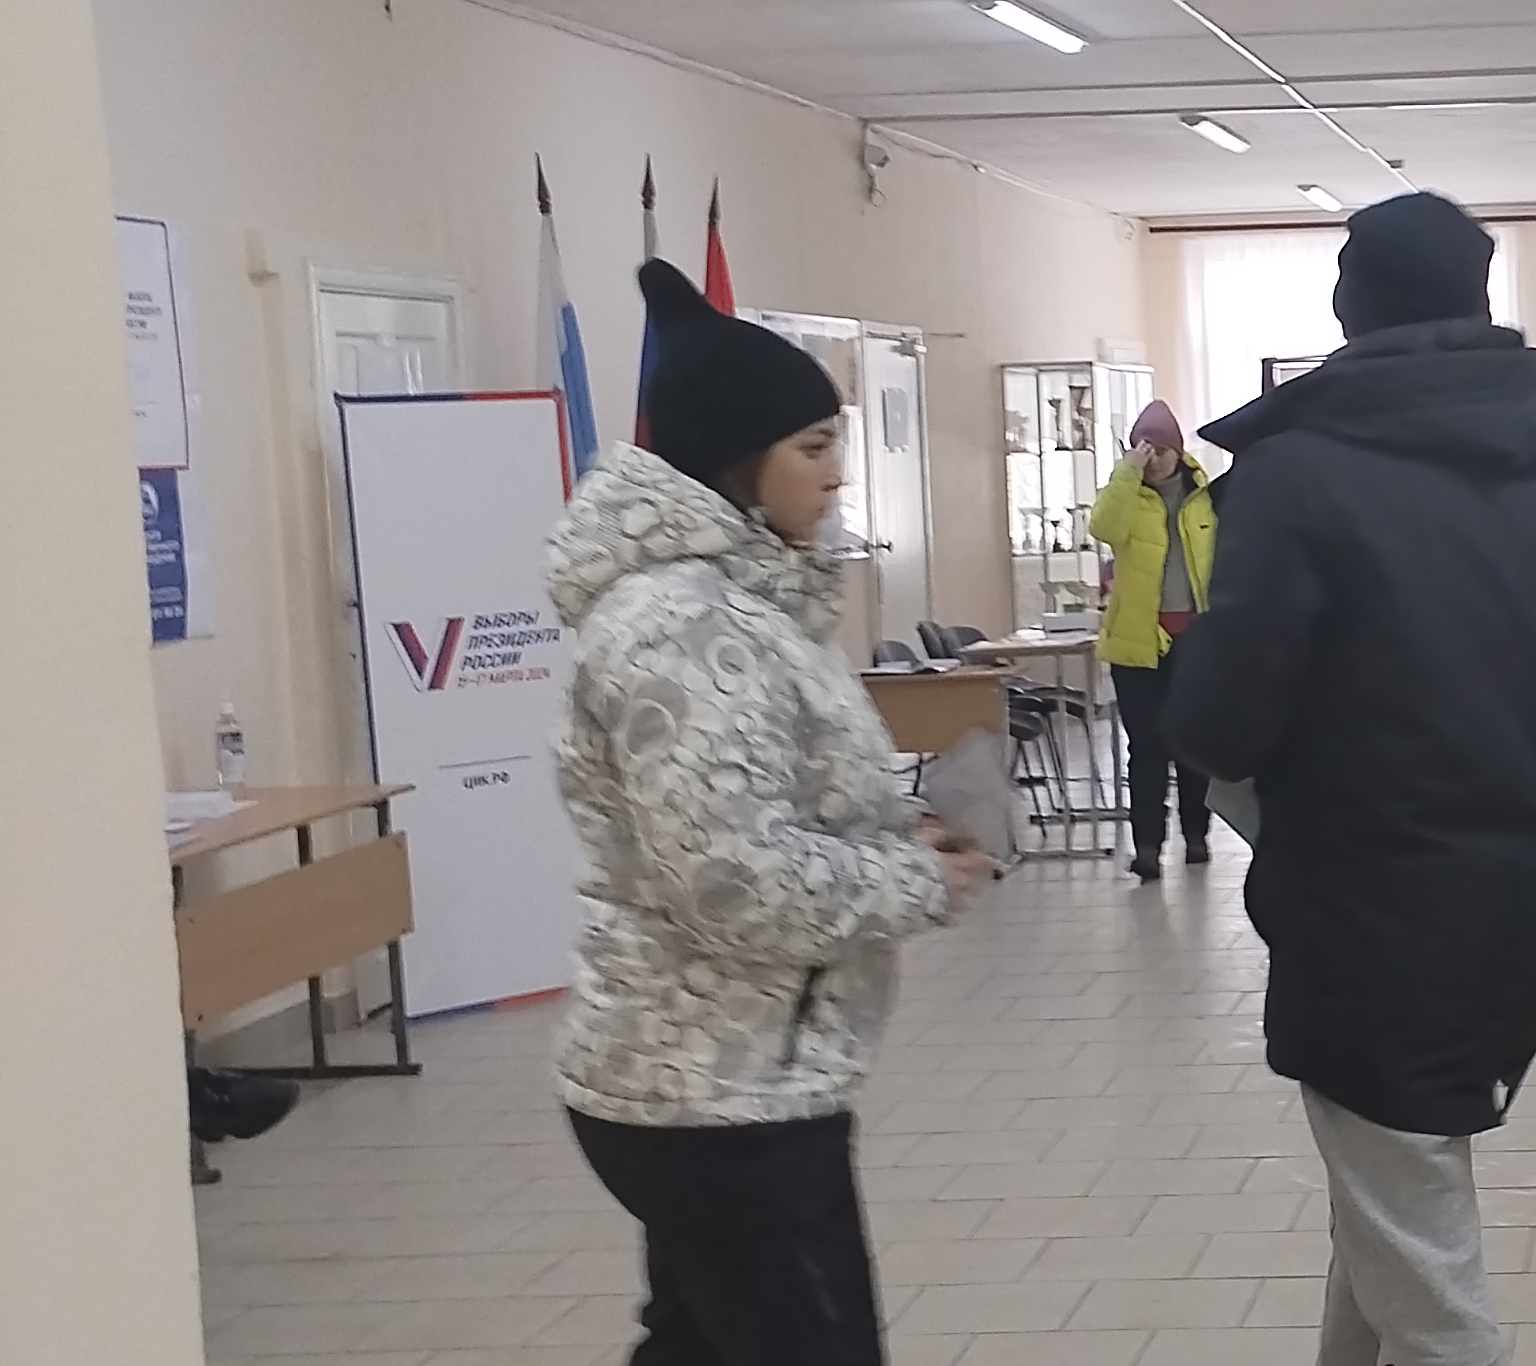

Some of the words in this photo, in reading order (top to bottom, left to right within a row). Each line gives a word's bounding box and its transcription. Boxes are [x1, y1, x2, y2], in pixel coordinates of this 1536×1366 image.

[473, 611, 540, 630] ВЫБОРЫ
[467, 628, 560, 650] ПРЕЗИДЕНТА
[461, 652, 522, 671] РОССИИ
